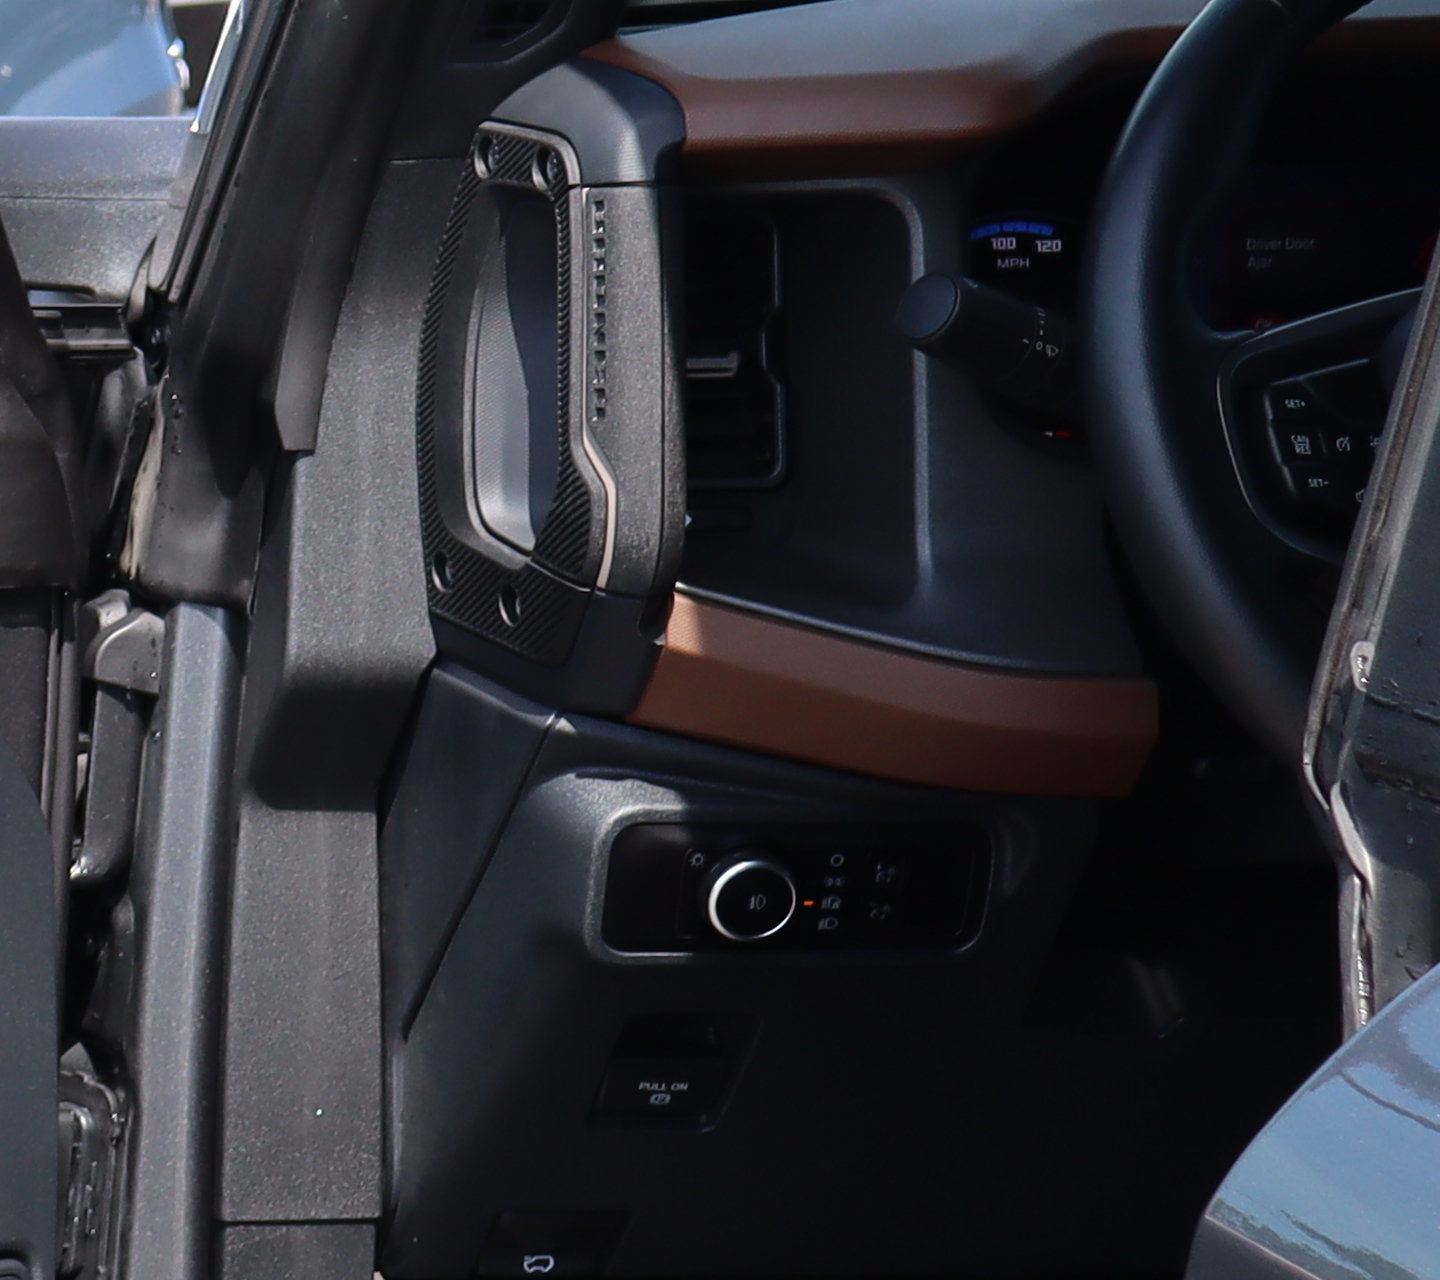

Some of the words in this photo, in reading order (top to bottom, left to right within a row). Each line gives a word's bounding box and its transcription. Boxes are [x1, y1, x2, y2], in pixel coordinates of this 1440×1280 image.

[991, 237, 1017, 250] 100
[1035, 240, 1062, 253] 120
[997, 258, 1030, 270] MPH
[638, 1081, 667, 1091] PULL
[670, 1082, 689, 1091] ON
